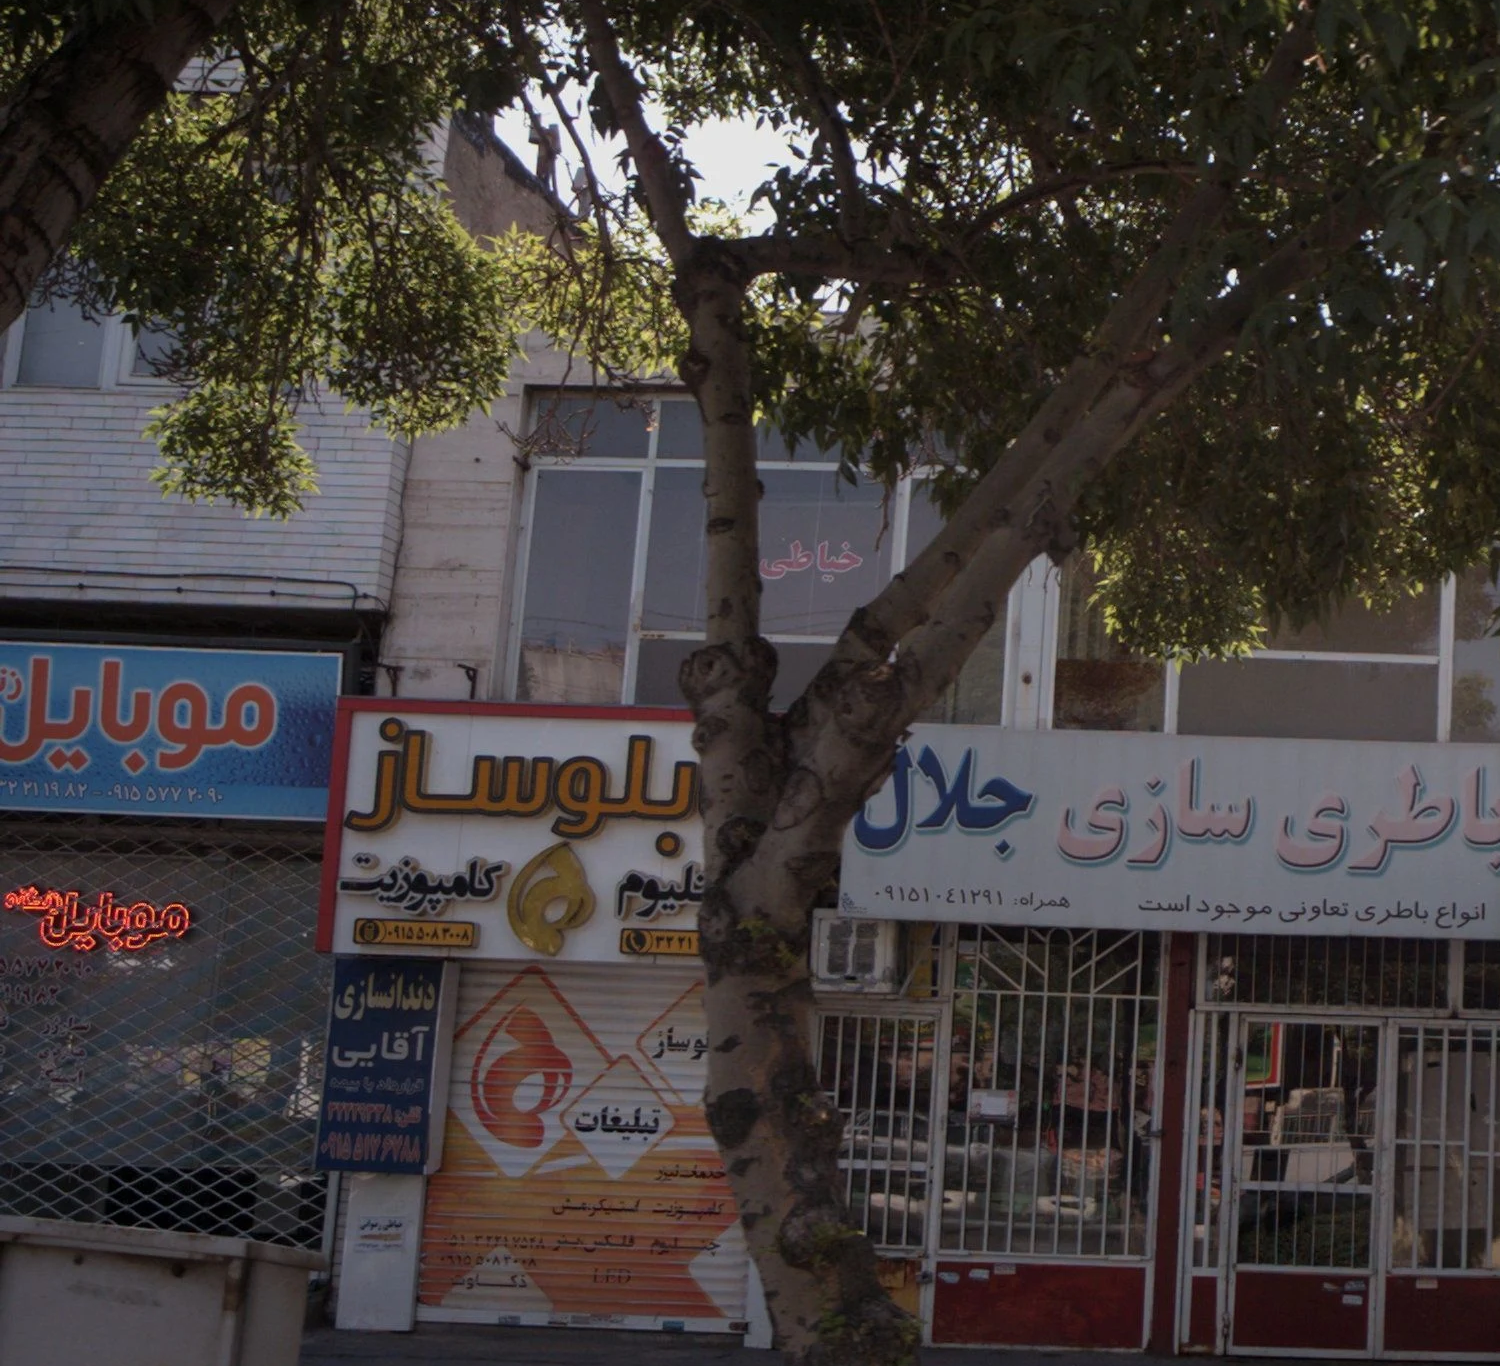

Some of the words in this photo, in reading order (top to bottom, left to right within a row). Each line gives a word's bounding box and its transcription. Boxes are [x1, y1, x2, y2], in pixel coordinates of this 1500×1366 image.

[758, 539, 864, 583] خیاطی
[0, 655, 277, 773] موبایل
[344, 717, 700, 858] بلوساز
[852, 741, 1037, 856] جلال
[1056, 755, 1256, 871] سازی
[339, 852, 508, 916] کامپوزیت
[616, 860, 703, 921] نلیوم
[1137, 894, 1191, 913] است
[38, 889, 191, 952] موبایل
[1196, 898, 1272, 920] موجود
[1278, 897, 1349, 923] تعاونی
[1354, 900, 1429, 925] باطری
[1434, 902, 1487, 928] انواع
[334, 972, 436, 1021] دندانسازی
[332, 1025, 431, 1068] آقایی
[574, 1105, 662, 1141] تبلیغات
